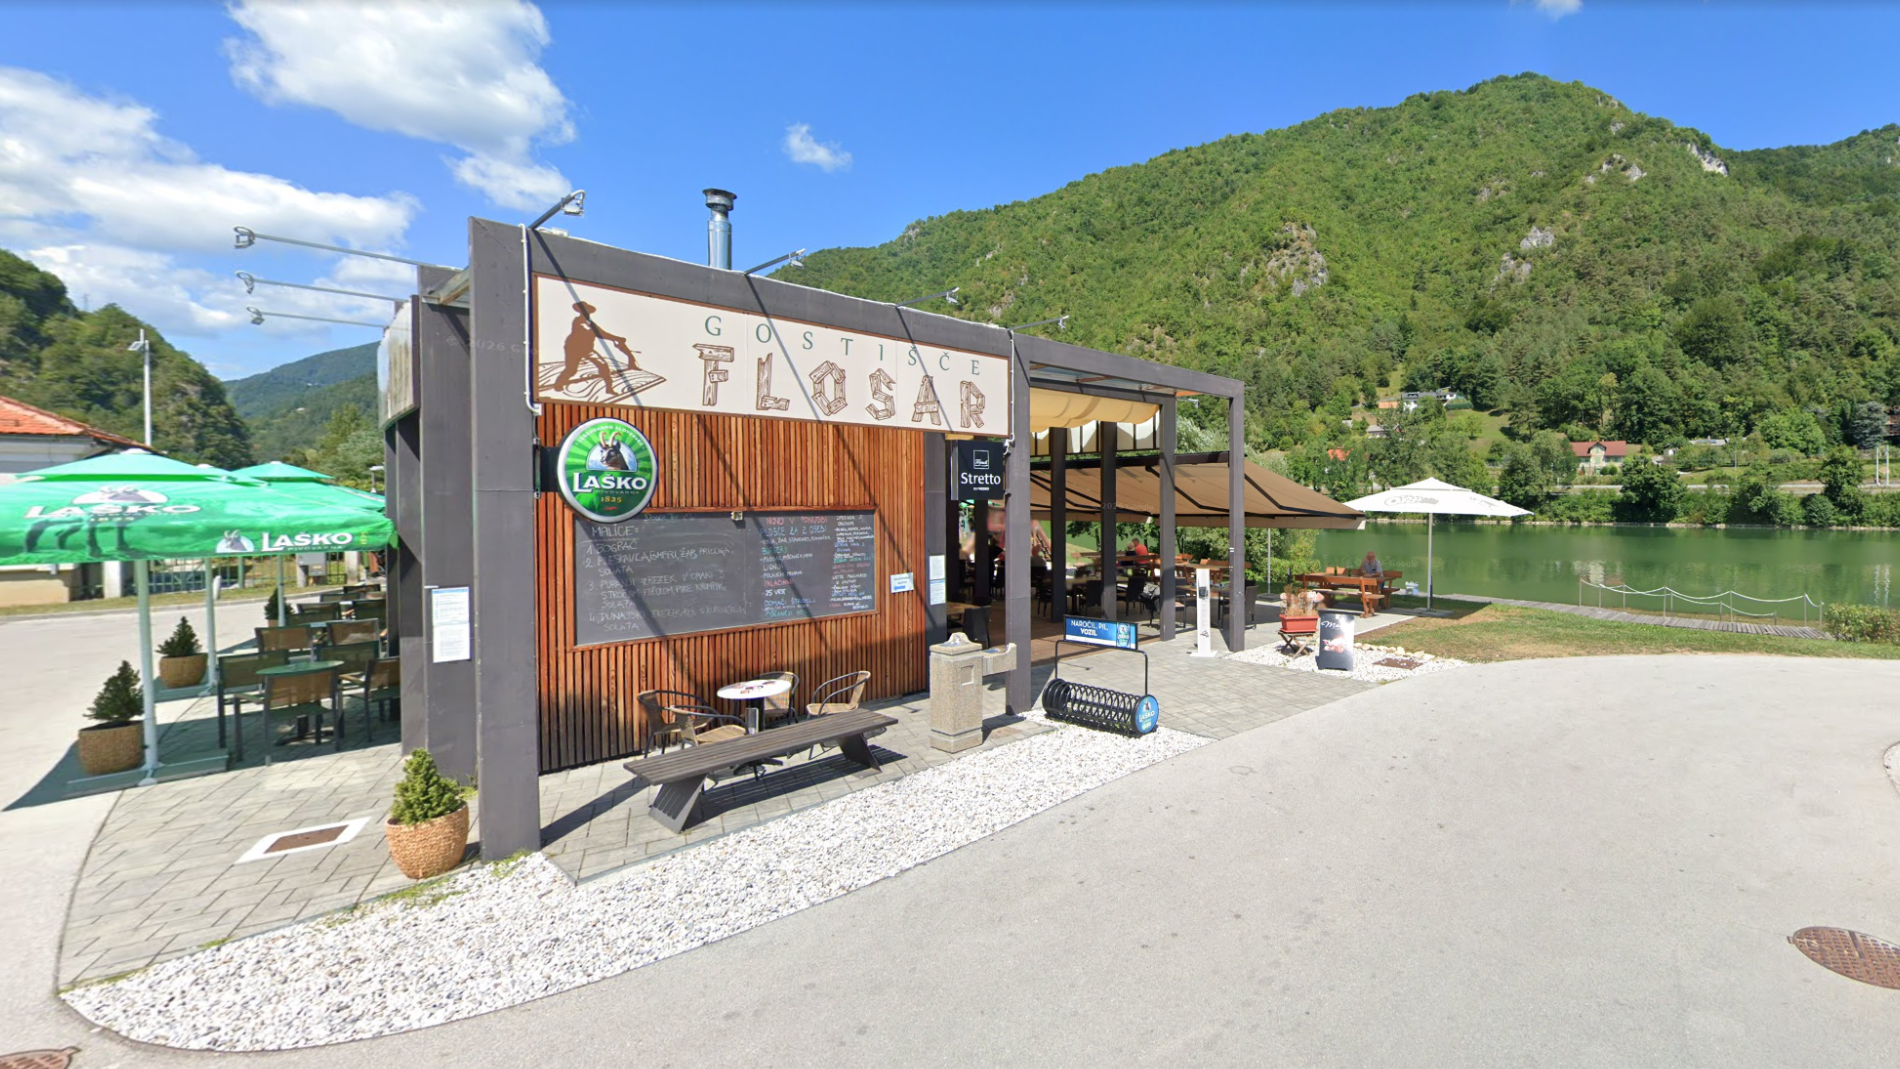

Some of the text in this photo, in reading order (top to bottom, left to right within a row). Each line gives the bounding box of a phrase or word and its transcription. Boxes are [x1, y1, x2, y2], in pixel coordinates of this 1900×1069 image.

[704, 314, 981, 377] GOSTIŠČE
[692, 343, 987, 429] FLOSAR
[573, 472, 647, 493] LAŠKO
[960, 472, 1001, 485] Stretto
[600, 496, 622, 504] 1825
[261, 531, 353, 552] LAŠKO
